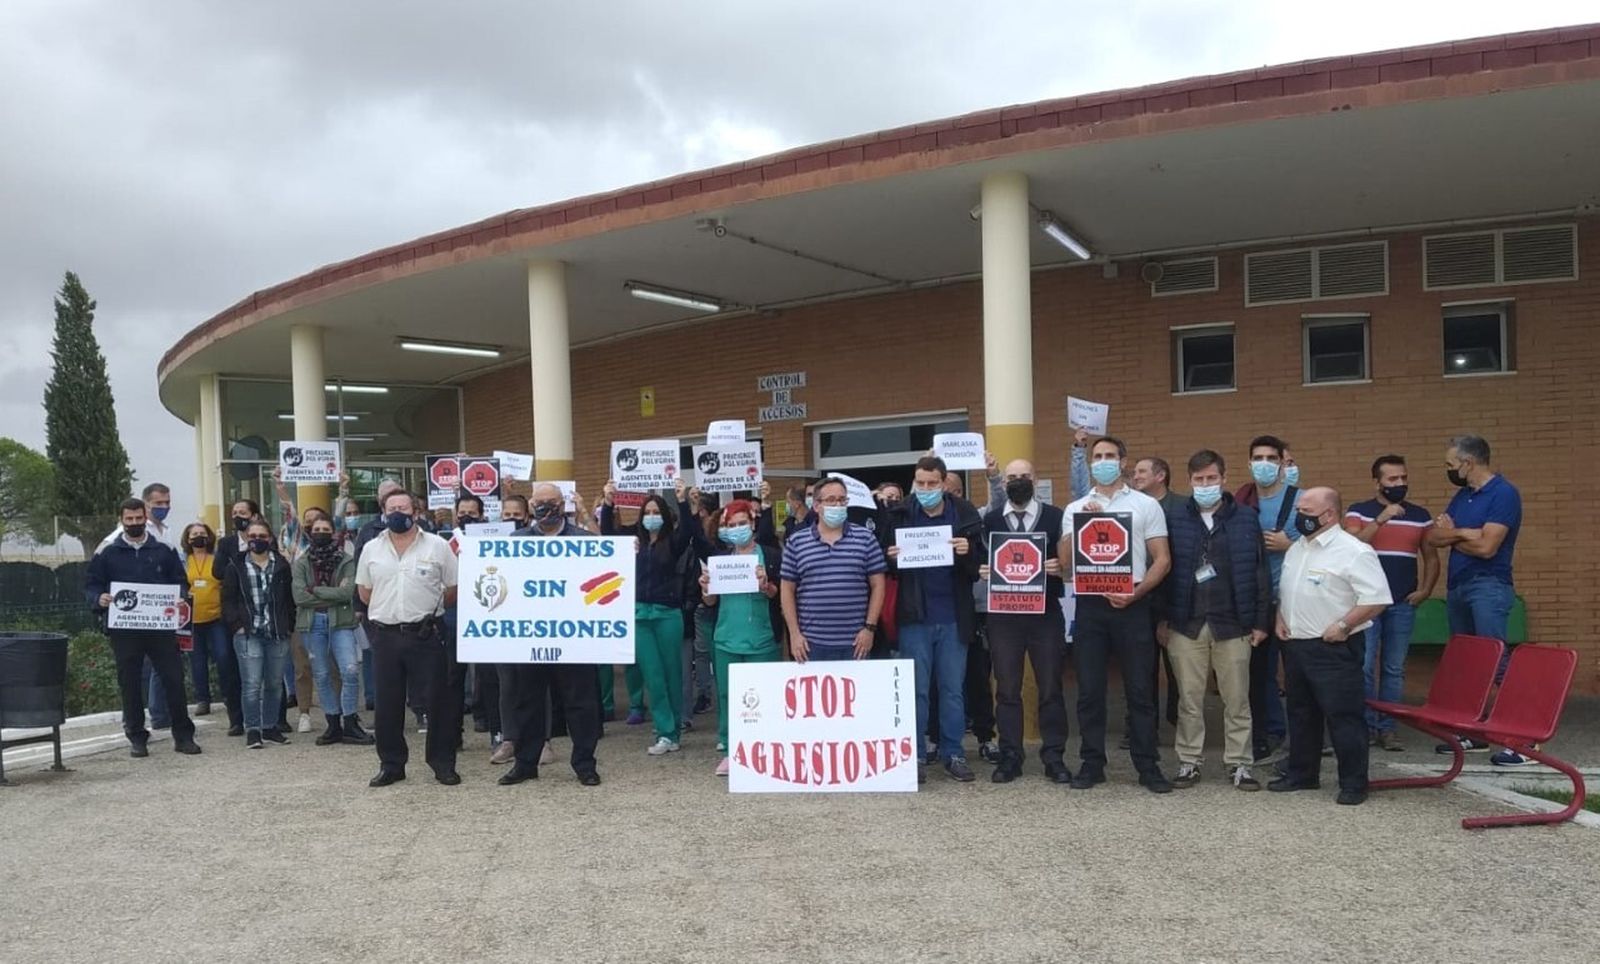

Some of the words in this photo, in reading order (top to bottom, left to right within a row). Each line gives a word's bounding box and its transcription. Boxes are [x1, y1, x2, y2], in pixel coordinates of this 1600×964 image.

[760, 374, 802, 389] CONTROL
[775, 391, 788, 403] DE
[761, 406, 804, 420] ACCESOS
[470, 480, 493, 488] STOP
[701, 483, 743, 491] AUTORIDAD
[478, 540, 615, 558] PRISIONES
[1090, 543, 1120, 553] STOP
[1005, 563, 1034, 573] STOP
[1079, 575, 1130, 584] ESTATUTO
[522, 580, 567, 598] SIN
[1085, 585, 1124, 594] PROPIO
[993, 594, 1042, 602] ESTATUTO
[462, 620, 628, 638] AGRESIONES
[530, 647, 562, 661] ACAIP
[784, 675, 857, 719] STOP
[893, 666, 901, 727] ACAIP
[733, 736, 912, 786] AGRESIONES
